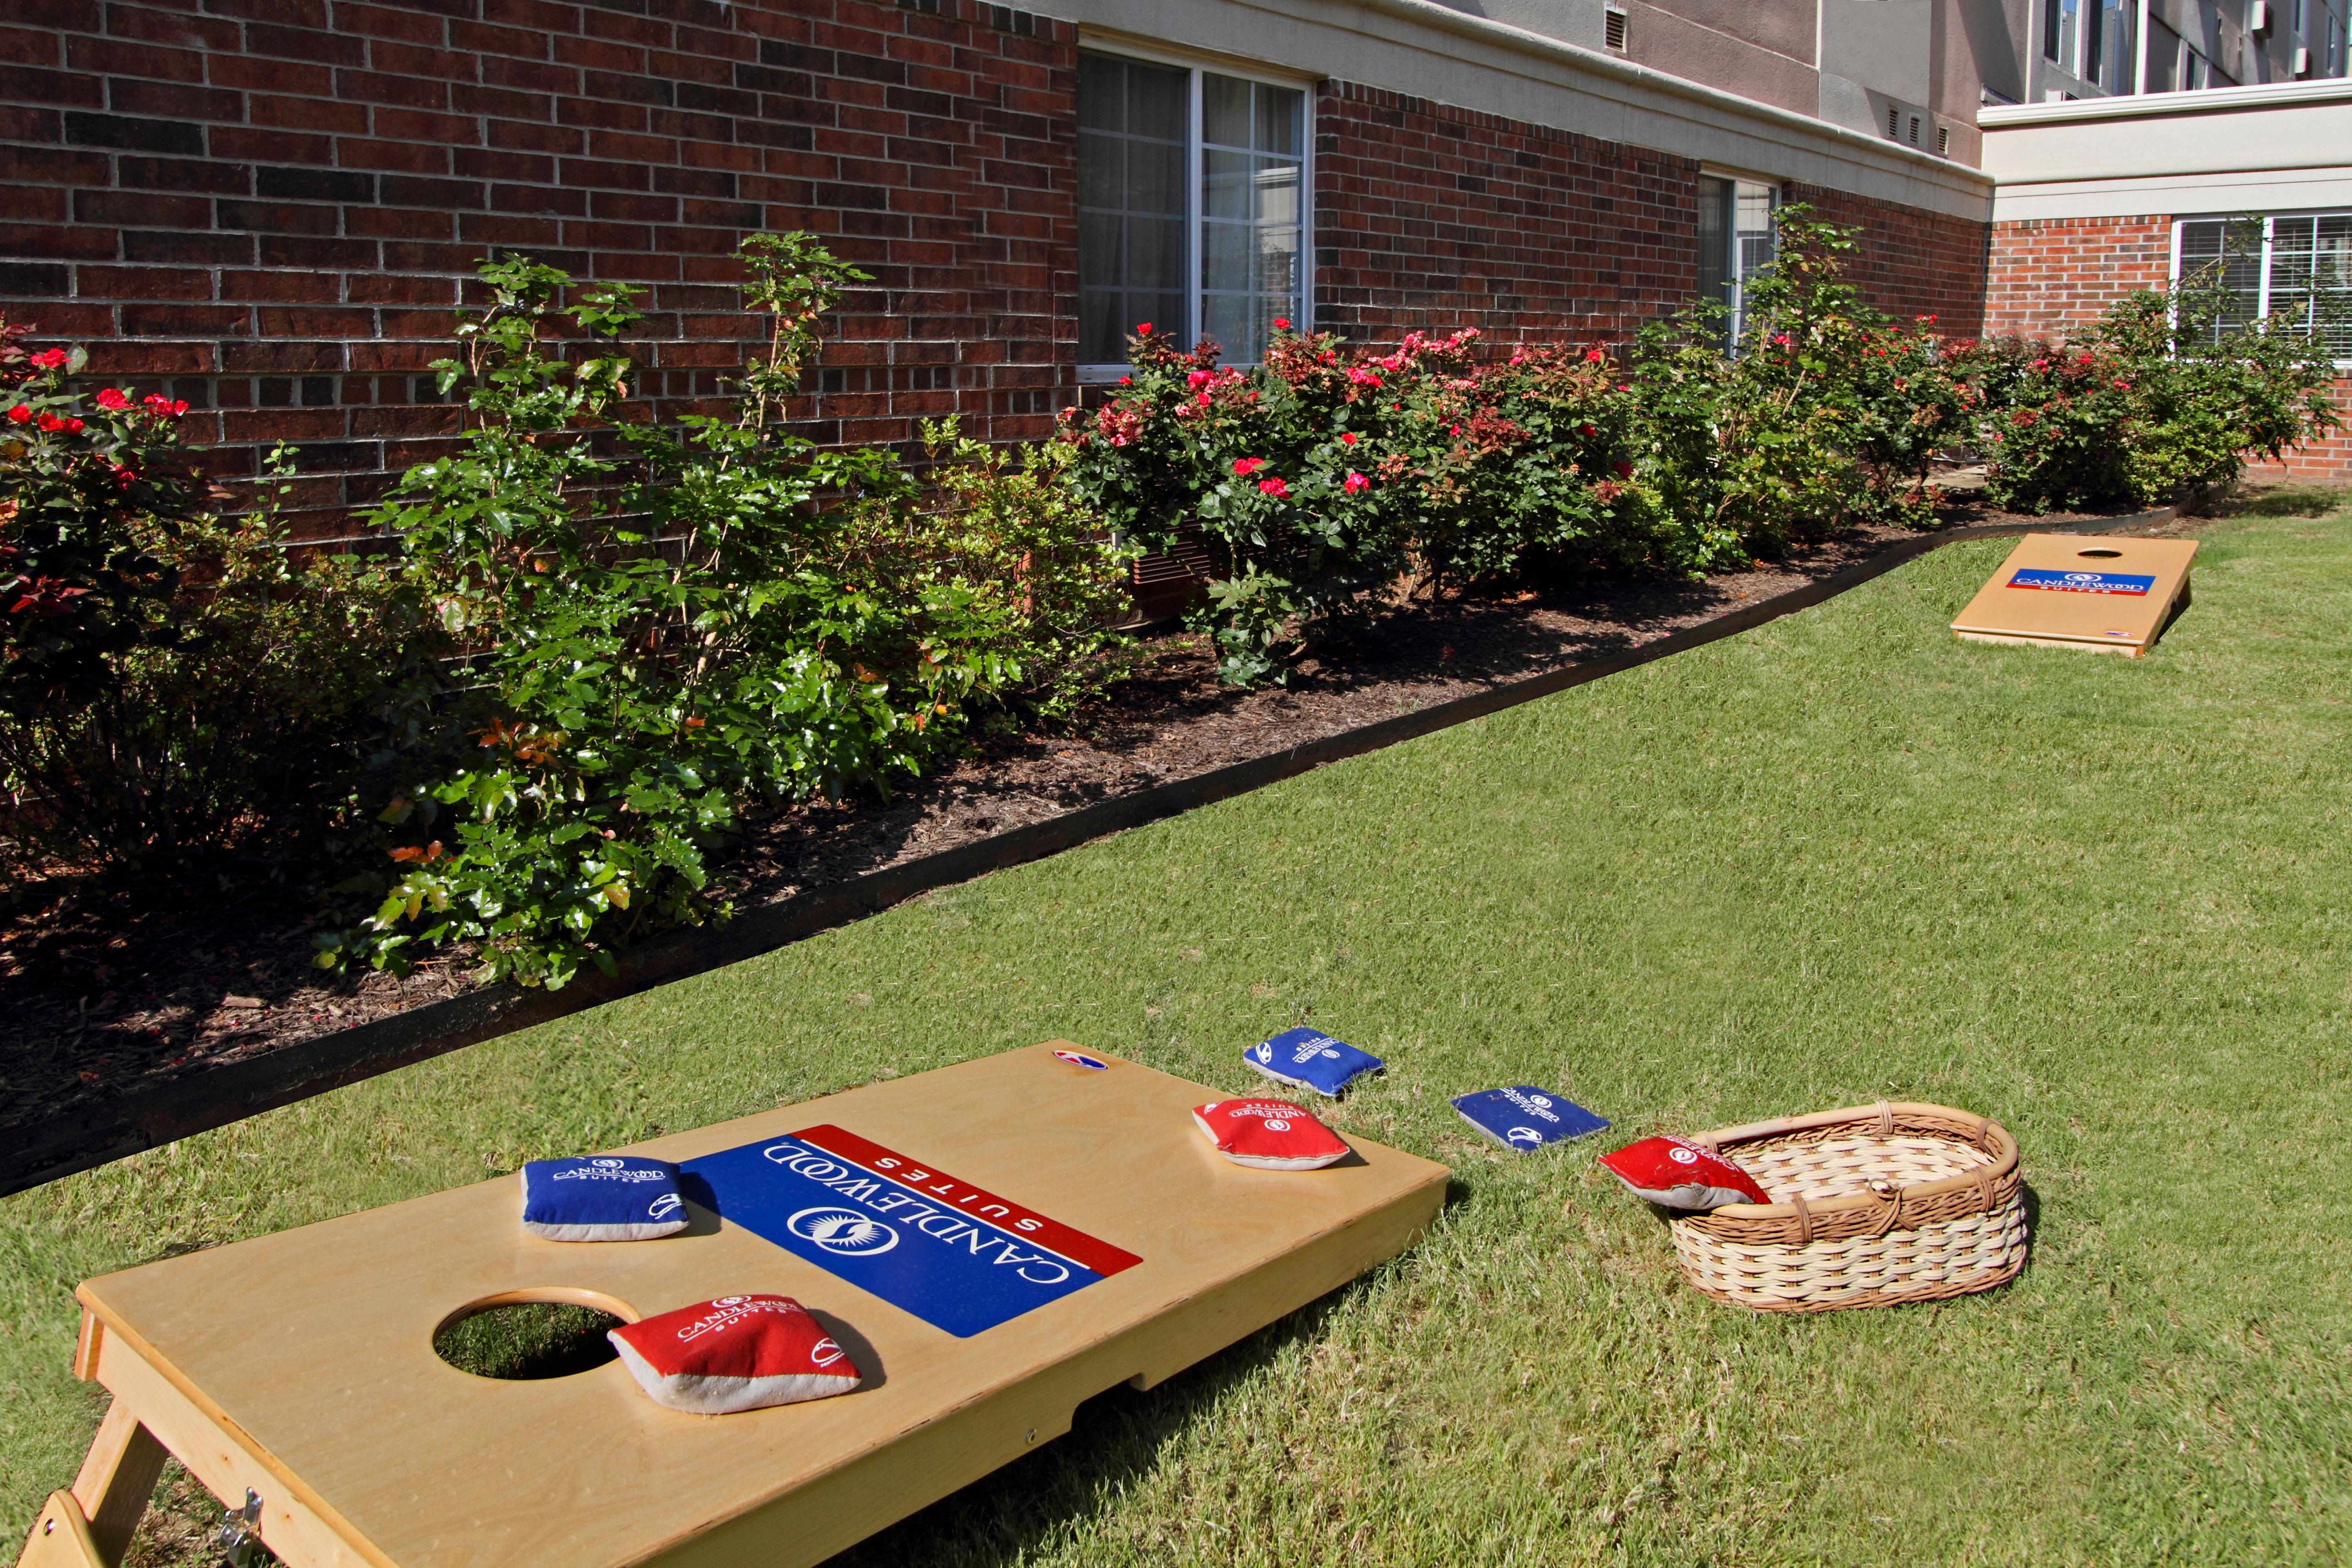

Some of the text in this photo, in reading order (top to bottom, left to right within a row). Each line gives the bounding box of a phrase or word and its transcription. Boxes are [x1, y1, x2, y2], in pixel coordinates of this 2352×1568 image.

[2016, 578, 2144, 590] CANDLEWOOD
[2040, 586, 2111, 594] SUITES
[1230, 1109, 1313, 1119] ANDLEWOOD
[553, 1167, 666, 1179] CANDLEWOOD
[875, 1157, 1043, 1232] SUITES
[764, 1145, 1070, 1284] CANDLEWOOD
[715, 1307, 786, 1332] SUITES
